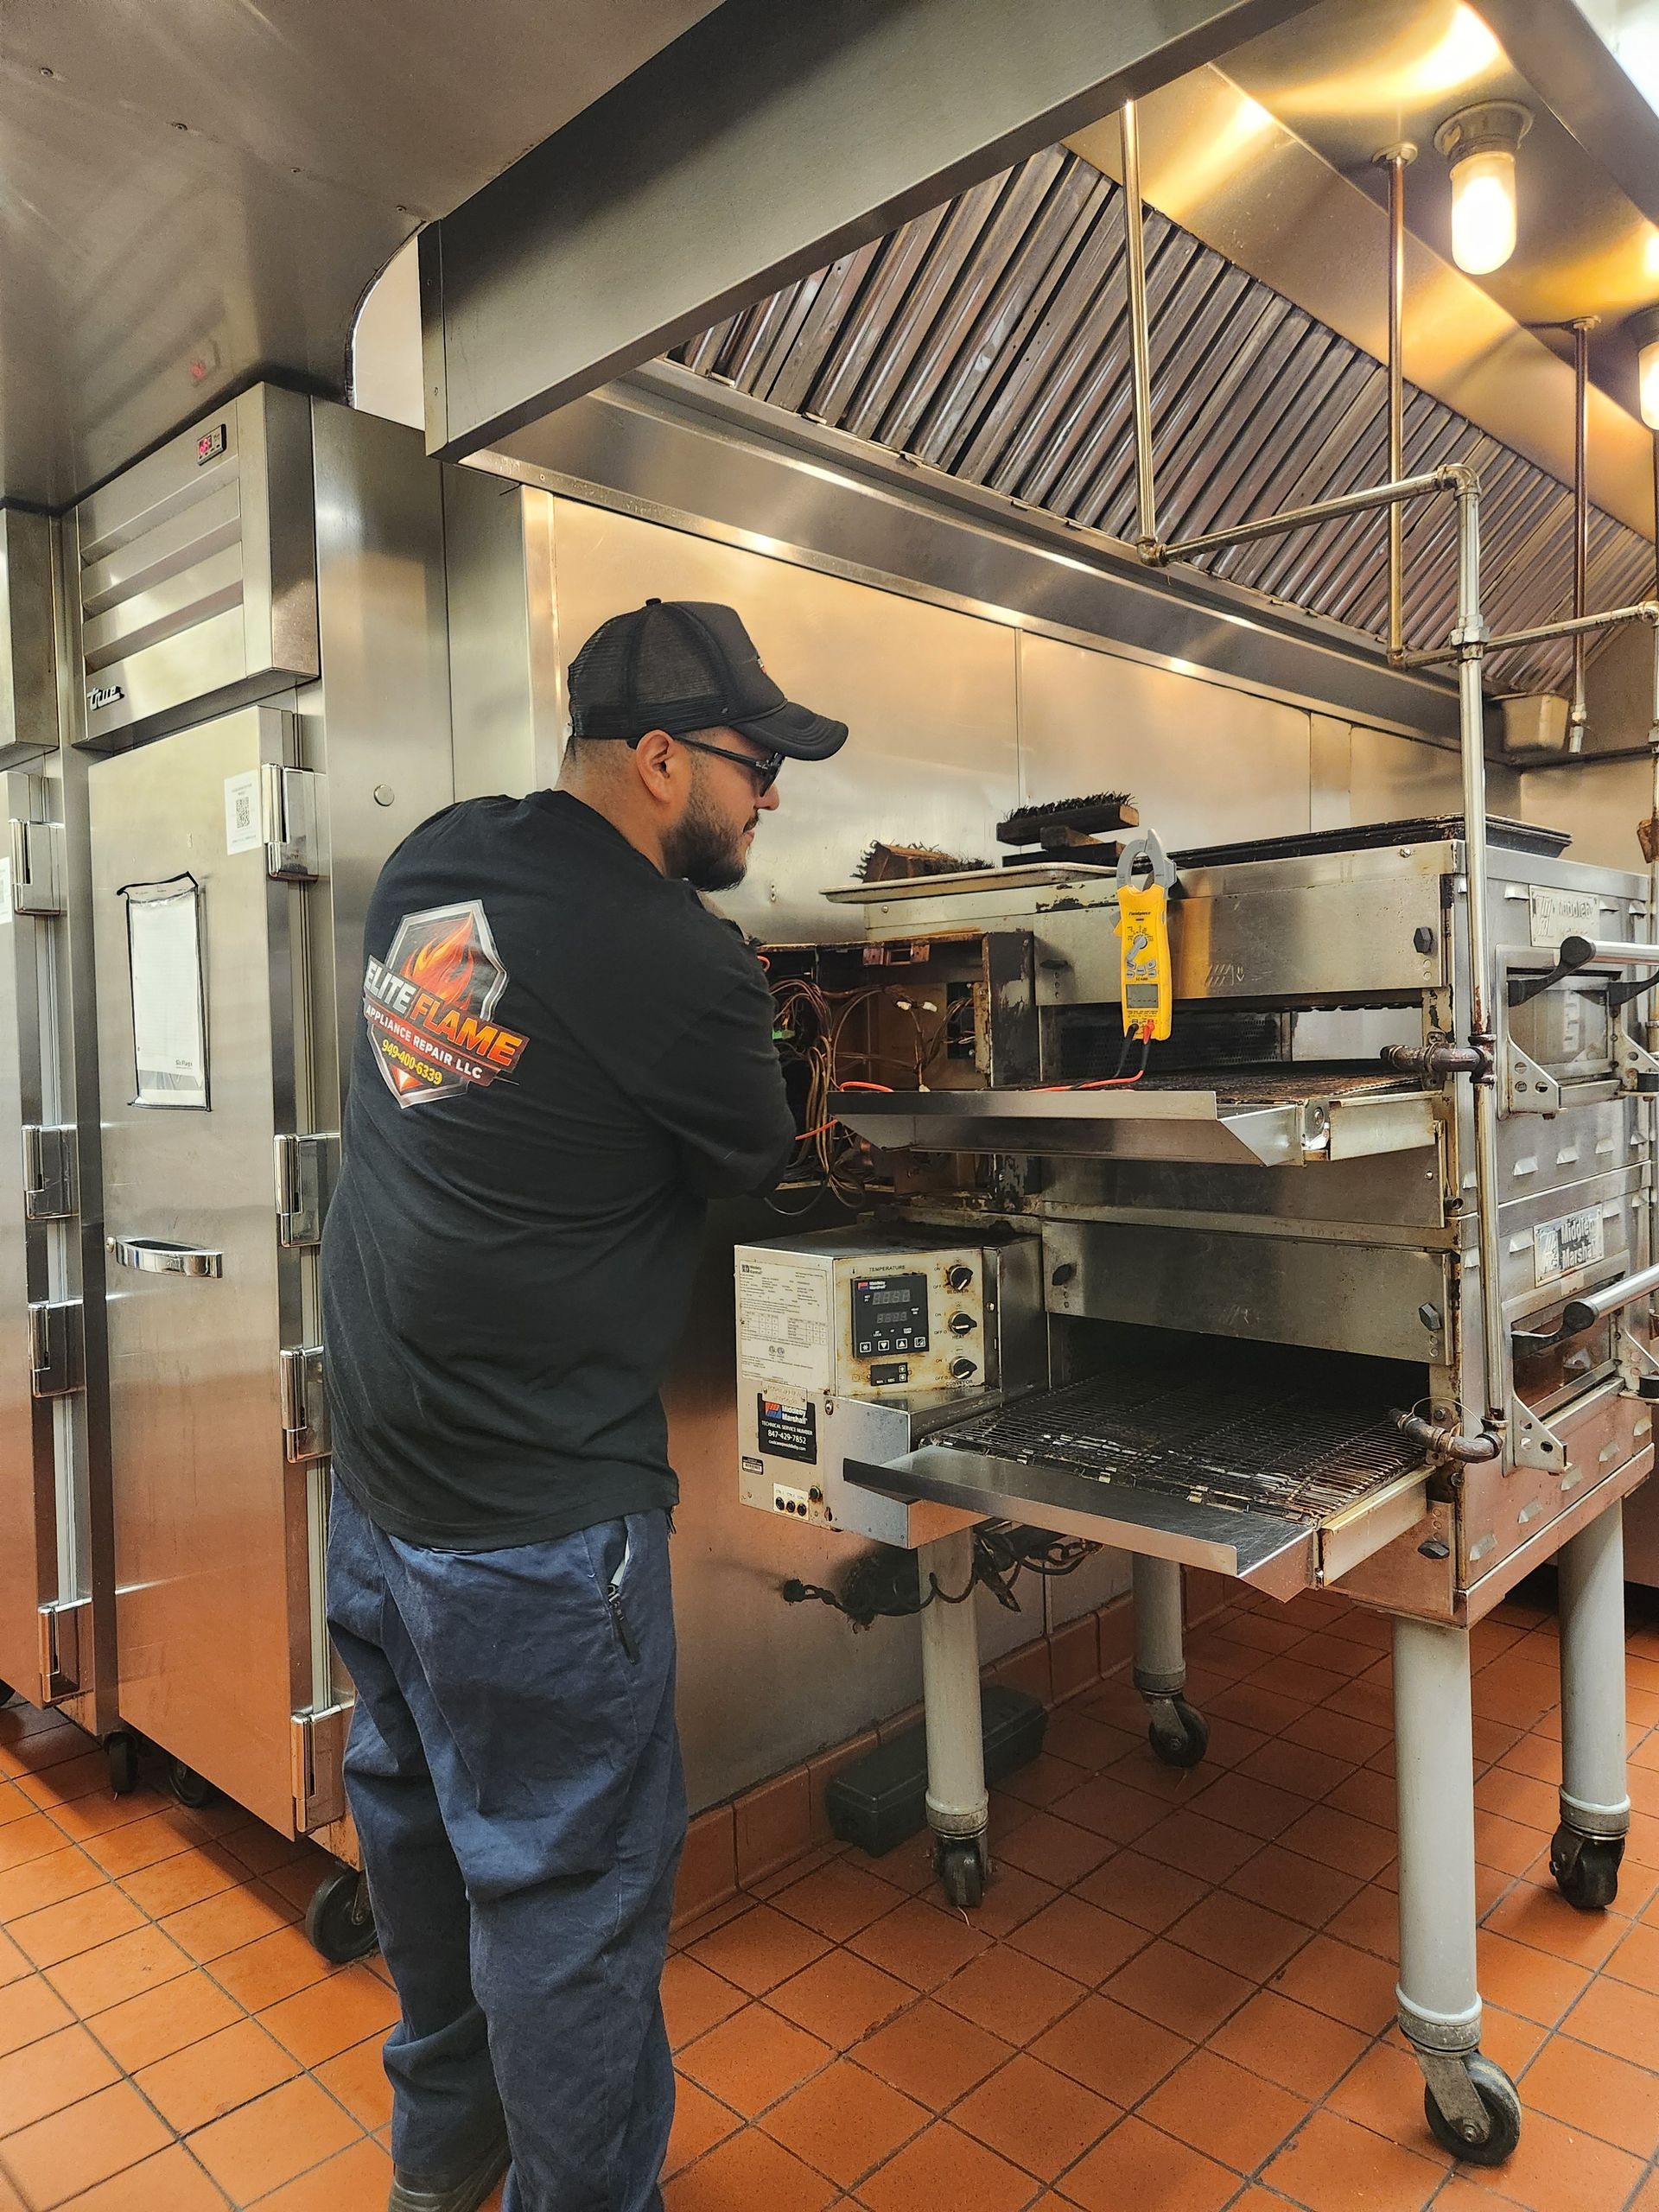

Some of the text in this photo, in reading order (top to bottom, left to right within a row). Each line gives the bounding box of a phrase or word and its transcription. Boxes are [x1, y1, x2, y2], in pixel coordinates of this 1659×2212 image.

[364, 960, 523, 1067] ELITE FLAME
[365, 1004, 483, 1079] APPLIANCE REPAIR LLC
[381, 1039, 443, 1085] 949-400-6339
[761, 1420, 782, 1429] TECHNICAL
[781, 1424, 796, 1433] SERVICE
[781, 1413, 806, 1425] Marshall
[767, 1429, 806, 1445] 847-429-7852
